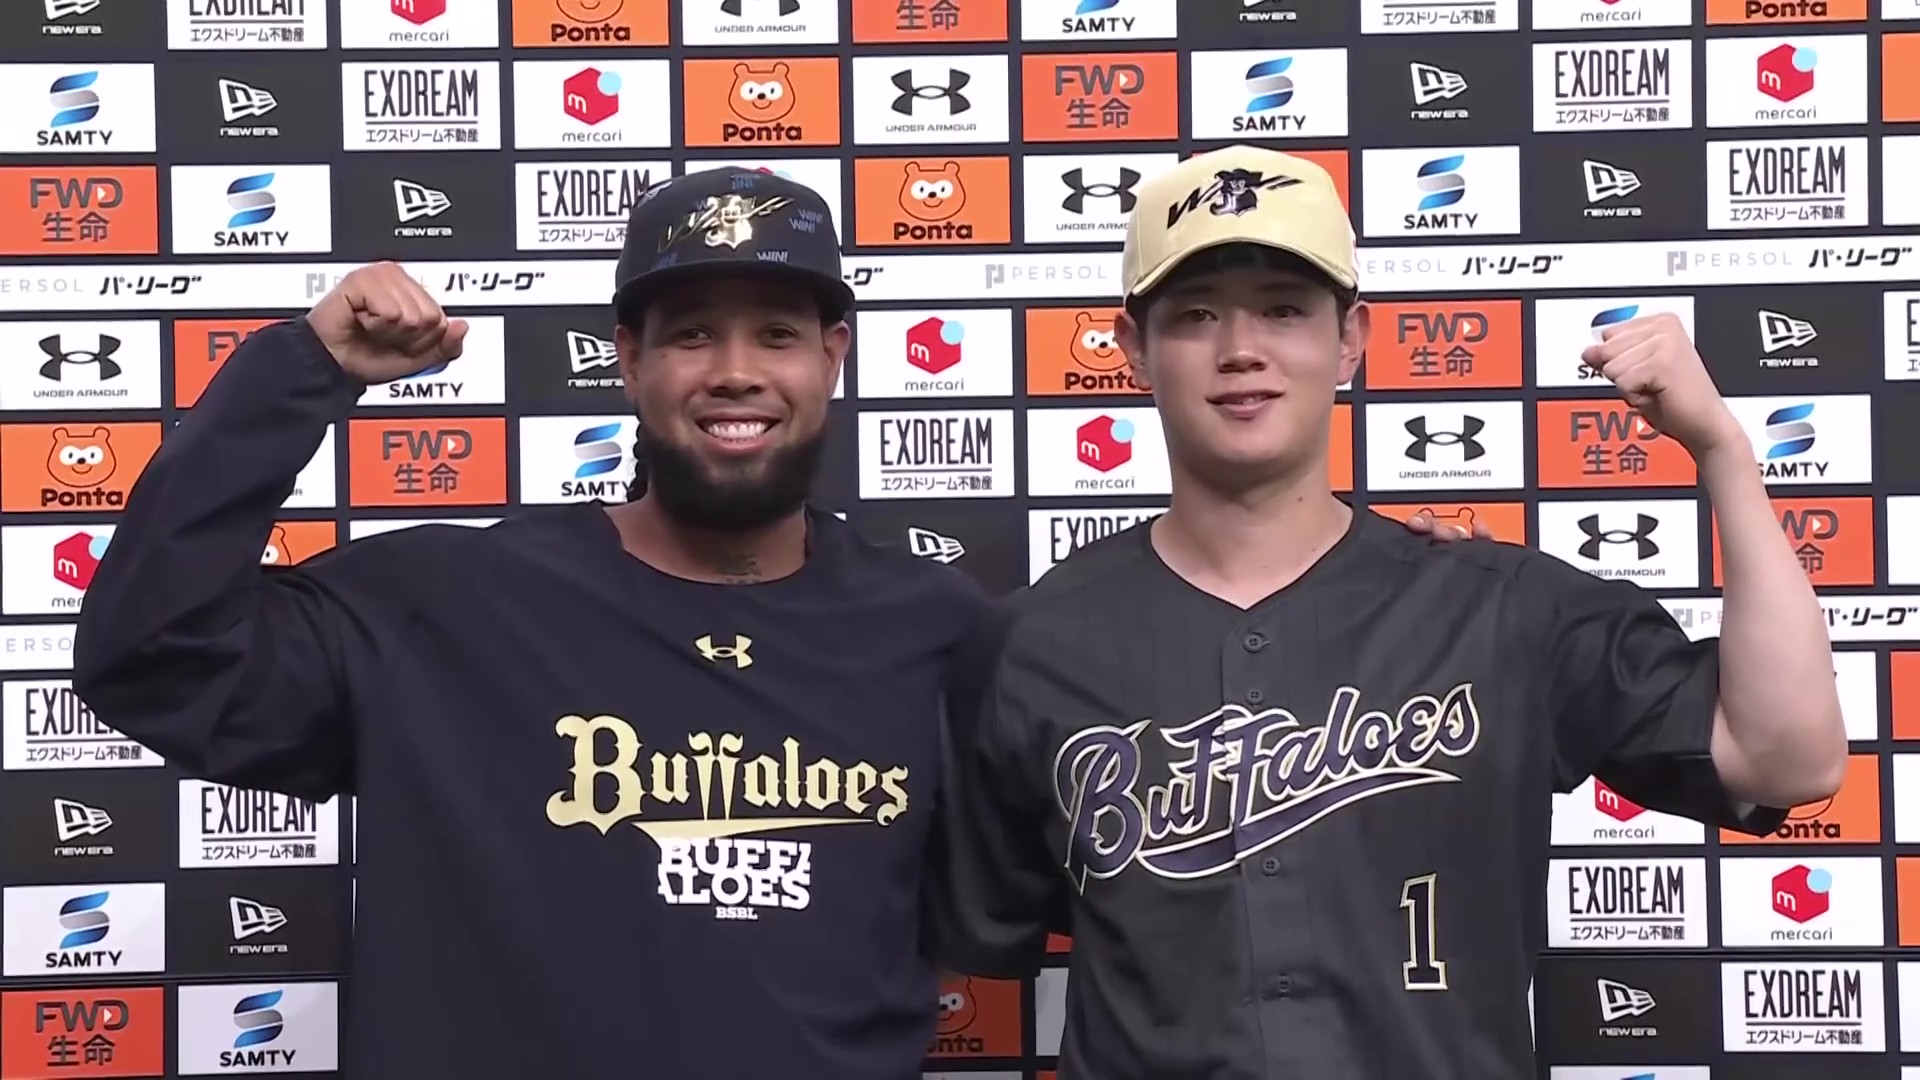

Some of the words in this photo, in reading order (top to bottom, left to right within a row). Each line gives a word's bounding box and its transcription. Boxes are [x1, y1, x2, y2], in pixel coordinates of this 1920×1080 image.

[896, 0, 960, 30] 生命
[1580, 9, 1641, 22] mercari
[1745, 0, 1828, 18] Ponta
[1062, 17, 1136, 33] SAMTY
[1383, 10, 1496, 26] エクスドリーム不動産
[190, 27, 304, 42] エクスドリーム不動産
[389, 29, 449, 42] mercari
[551, 23, 631, 42] Ponta
[715, 25, 753, 33] UNDER
[756, 24, 806, 33] ARMOUR
[1055, 64, 1144, 96] FWD
[1555, 48, 1670, 97] EXDREAM
[364, 69, 478, 117] EXDREAM
[1066, 98, 1131, 128] 生命
[1556, 107, 1669, 123] エクスドリーム不動産
[1755, 106, 1817, 119] mercari
[723, 122, 802, 141] Ponta
[927, 124, 976, 132] ARMOUR
[1233, 116, 1306, 131] SAMTY
[37, 131, 113, 145] SAMTY
[366, 129, 479, 143] エクスドリーム不動産
[562, 129, 622, 142] mercari
[1729, 146, 1845, 195] EXDREAM
[30, 178, 122, 208] FWD
[1730, 205, 1845, 221] エクスドリーム不動産
[42, 212, 110, 243] 生命
[1404, 215, 1477, 229] SAMTY
[214, 231, 289, 246] SAMTY
[539, 228, 630, 243] エクスドリーム不
[894, 222, 973, 240] Ponta
[756, 251, 788, 263] WIN!
[1695, 254, 1792, 267] PERSOL
[1013, 267, 1108, 280] PERSOL
[1368, 260, 1446, 274] ERSOL
[0, 279, 82, 293] ERSOL
[1398, 312, 1488, 343] FWD
[1410, 345, 1474, 377] 生命
[389, 383, 463, 398] SAMTY
[905, 379, 964, 391] mercari
[33, 390, 74, 398] UNDER
[77, 389, 128, 397] ARMOUR
[382, 430, 472, 460] FWD
[880, 418, 992, 466] EXDREAM
[1583, 444, 1648, 475] 生命
[394, 462, 459, 494] 生命
[1075, 476, 1135, 489] mercari
[1399, 471, 1437, 479] UNDER
[1440, 470, 1491, 478] ARMOUR
[561, 481, 634, 497] SAMTY
[881, 476, 992, 490] エクスドリーム不動産
[41, 488, 123, 507] Ponta
[1780, 508, 1838, 539] WD
[1797, 543, 1824, 573] 命
[1614, 568, 1666, 577] ARMOUR
[6, 638, 72, 651] ERSO
[26, 745, 142, 760] エクスドリーム不動産
[546, 714, 909, 836] Buffaloes
[1054, 683, 1480, 895] Buffaloes
[201, 787, 316, 832] EXDREAM
[1594, 826, 1655, 838] mercari
[1776, 821, 1840, 838] onta
[202, 845, 316, 860] エクスドリーム不動産
[1569, 867, 1684, 914] EXDREAM
[716, 907, 757, 919] BSBL
[1400, 873, 1448, 990] 1
[1570, 925, 1684, 940] エクスドリーム不動産
[1771, 929, 1832, 941] mercari
[46, 952, 122, 967] SAMTY
[1744, 970, 1861, 1018] EXDREAM
[35, 1000, 129, 1031] FWD
[1745, 1031, 1862, 1045] エクスドリーム不動産
[47, 1034, 115, 1067] 生命
[220, 1050, 296, 1067] SAMTY
